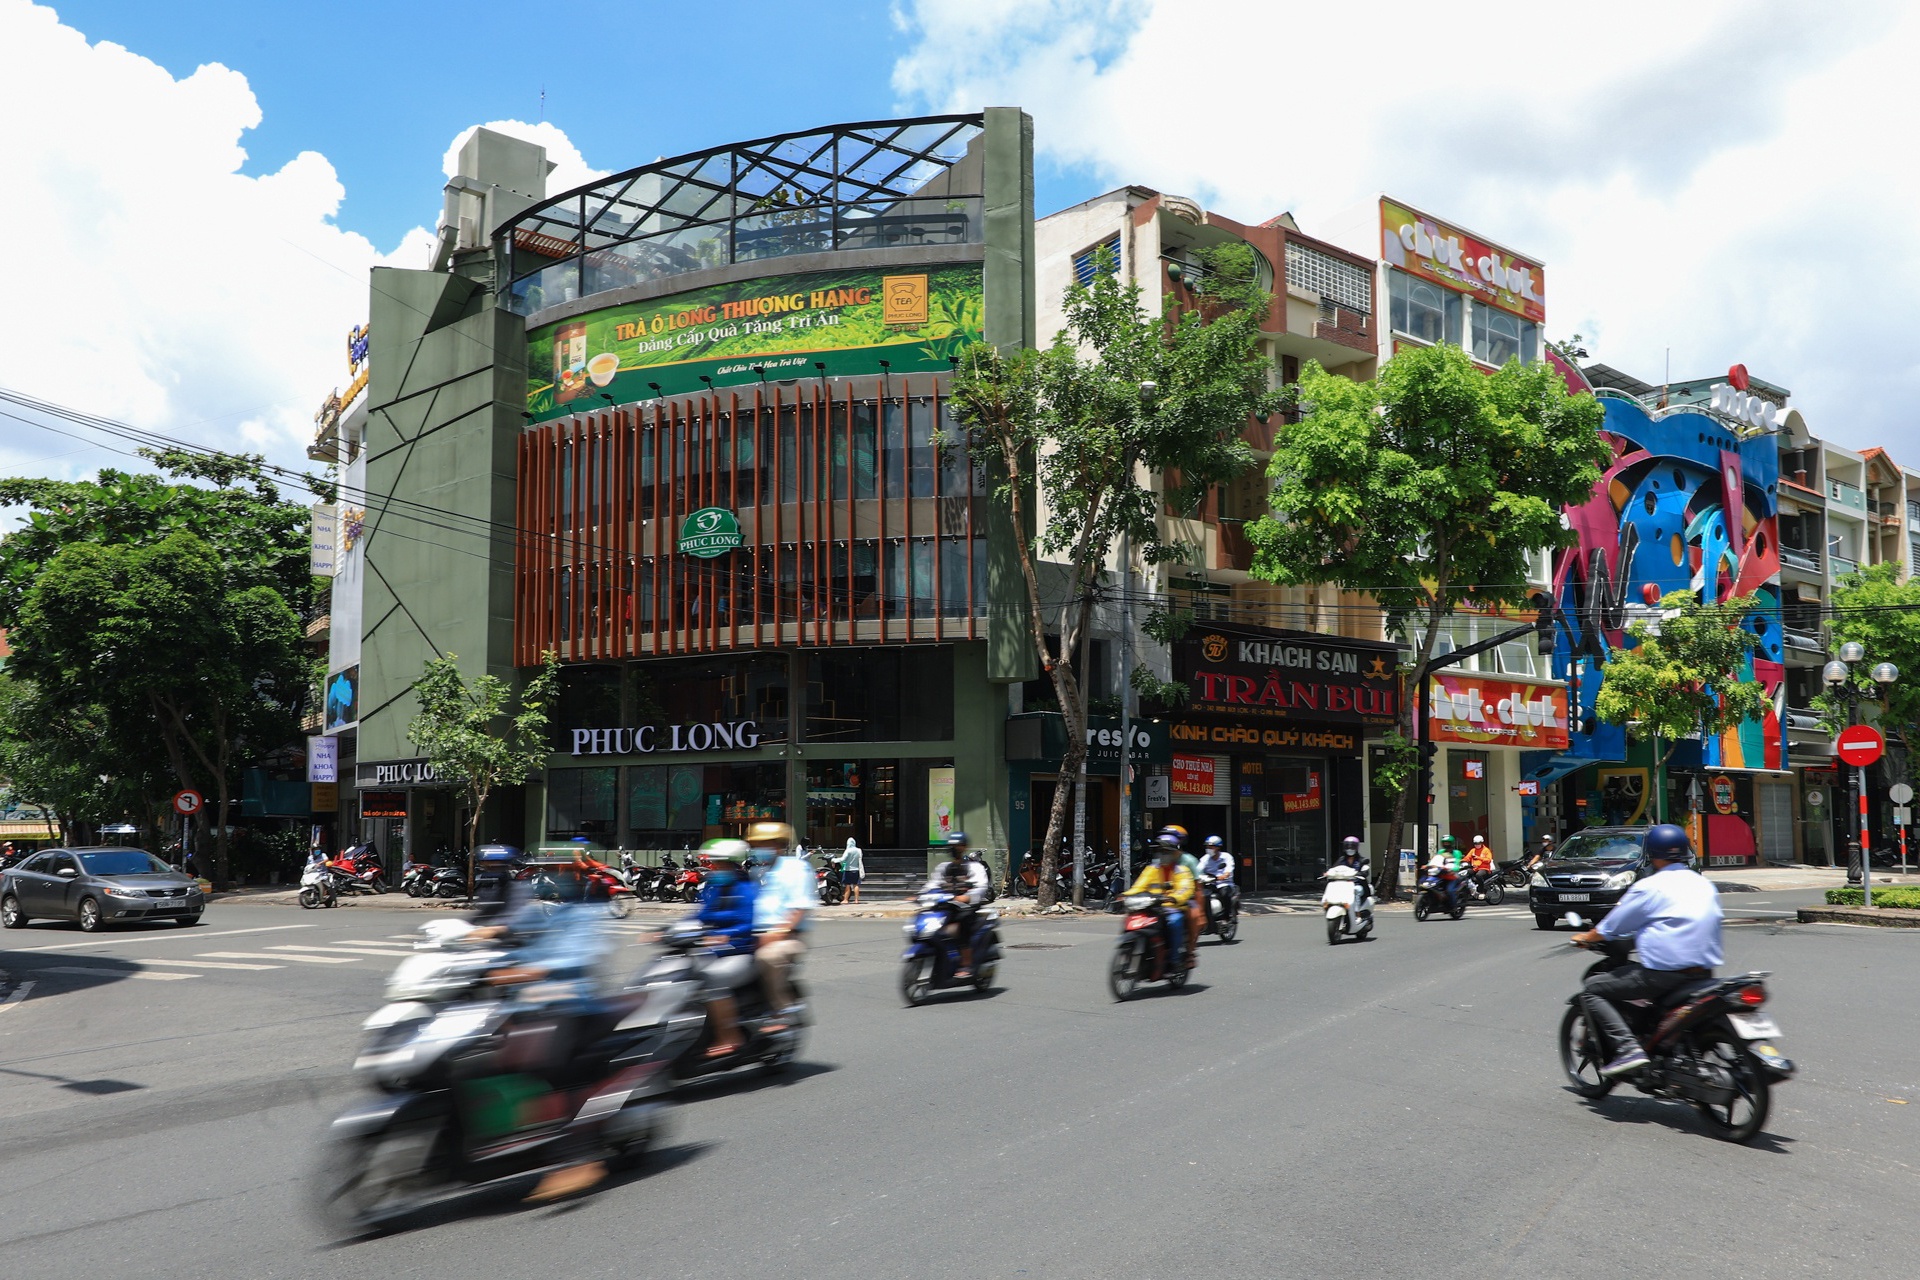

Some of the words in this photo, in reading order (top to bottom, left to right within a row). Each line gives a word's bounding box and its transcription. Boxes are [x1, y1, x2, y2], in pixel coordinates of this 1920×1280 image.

[895, 297, 912, 305] TEA
[615, 317, 647, 341] TRÀ
[650, 313, 664, 334] Ô
[668, 305, 716, 331] LONG
[720, 293, 804, 320] THƯỢNG
[810, 287, 870, 311] HẠNG
[638, 335, 673, 354] Đẳng
[676, 327, 704, 346] Cấp
[708, 322, 738, 342] Quà
[742, 318, 782, 336] Tặng
[788, 314, 811, 329] Tri
[815, 310, 839, 326] Ân
[680, 537, 708, 551] PHUC
[710, 536, 739, 546] LONG
[1238, 640, 1312, 669] KHÁCH
[1316, 650, 1358, 676] SẠN
[1194, 669, 1320, 711] TRẦN
[1324, 681, 1395, 716] BÙI
[571, 725, 655, 756] PHUC
[670, 720, 760, 751] LONG
[1086, 724, 1150, 748] resYo
[1169, 720, 1208, 742] KÍNH
[1211, 724, 1260, 744] CHÀO
[1262, 728, 1299, 747] QUÝ
[1301, 730, 1354, 750] KHÁCH
[376, 763, 412, 783] PHUC
[1172, 758, 1184, 769] CHO
[1186, 758, 1200, 771] THUÊ
[1200, 760, 1213, 772] NHÀ
[1242, 762, 1264, 774] HOTEL
[1015, 801, 1025, 810] 95
